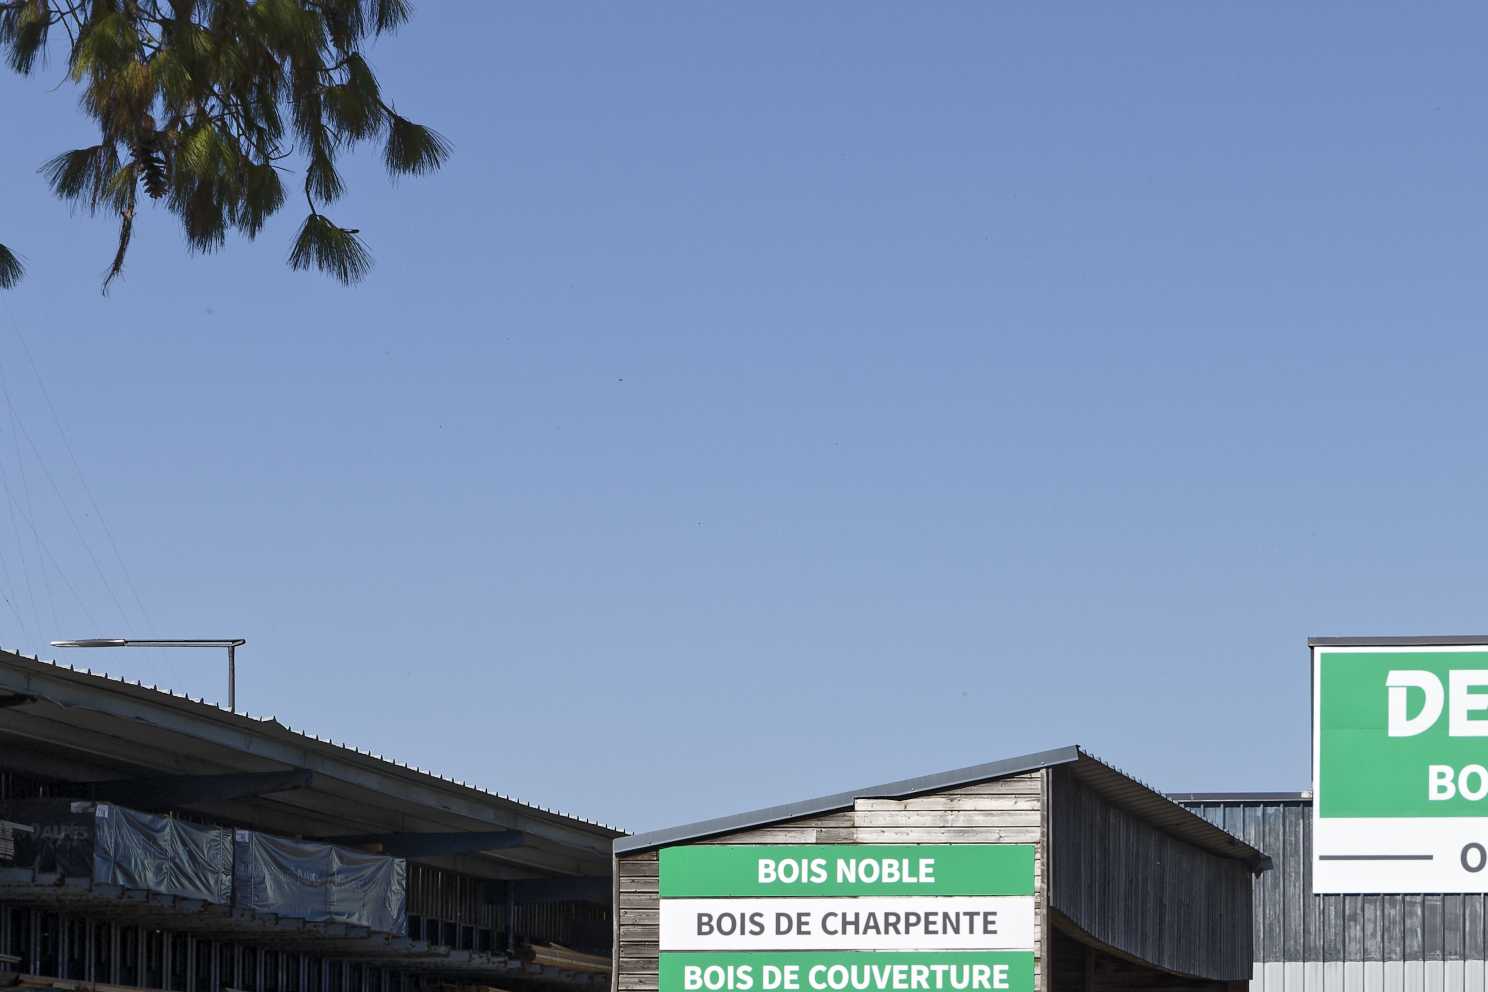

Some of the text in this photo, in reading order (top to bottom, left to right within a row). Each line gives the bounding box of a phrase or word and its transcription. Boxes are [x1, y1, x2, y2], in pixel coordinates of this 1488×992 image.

[758, 858, 935, 884] BOIS NOBLE
[696, 911, 998, 936] BOIS DE CHARPENTE
[684, 964, 1009, 991] BOIS DE COUVERTURE
